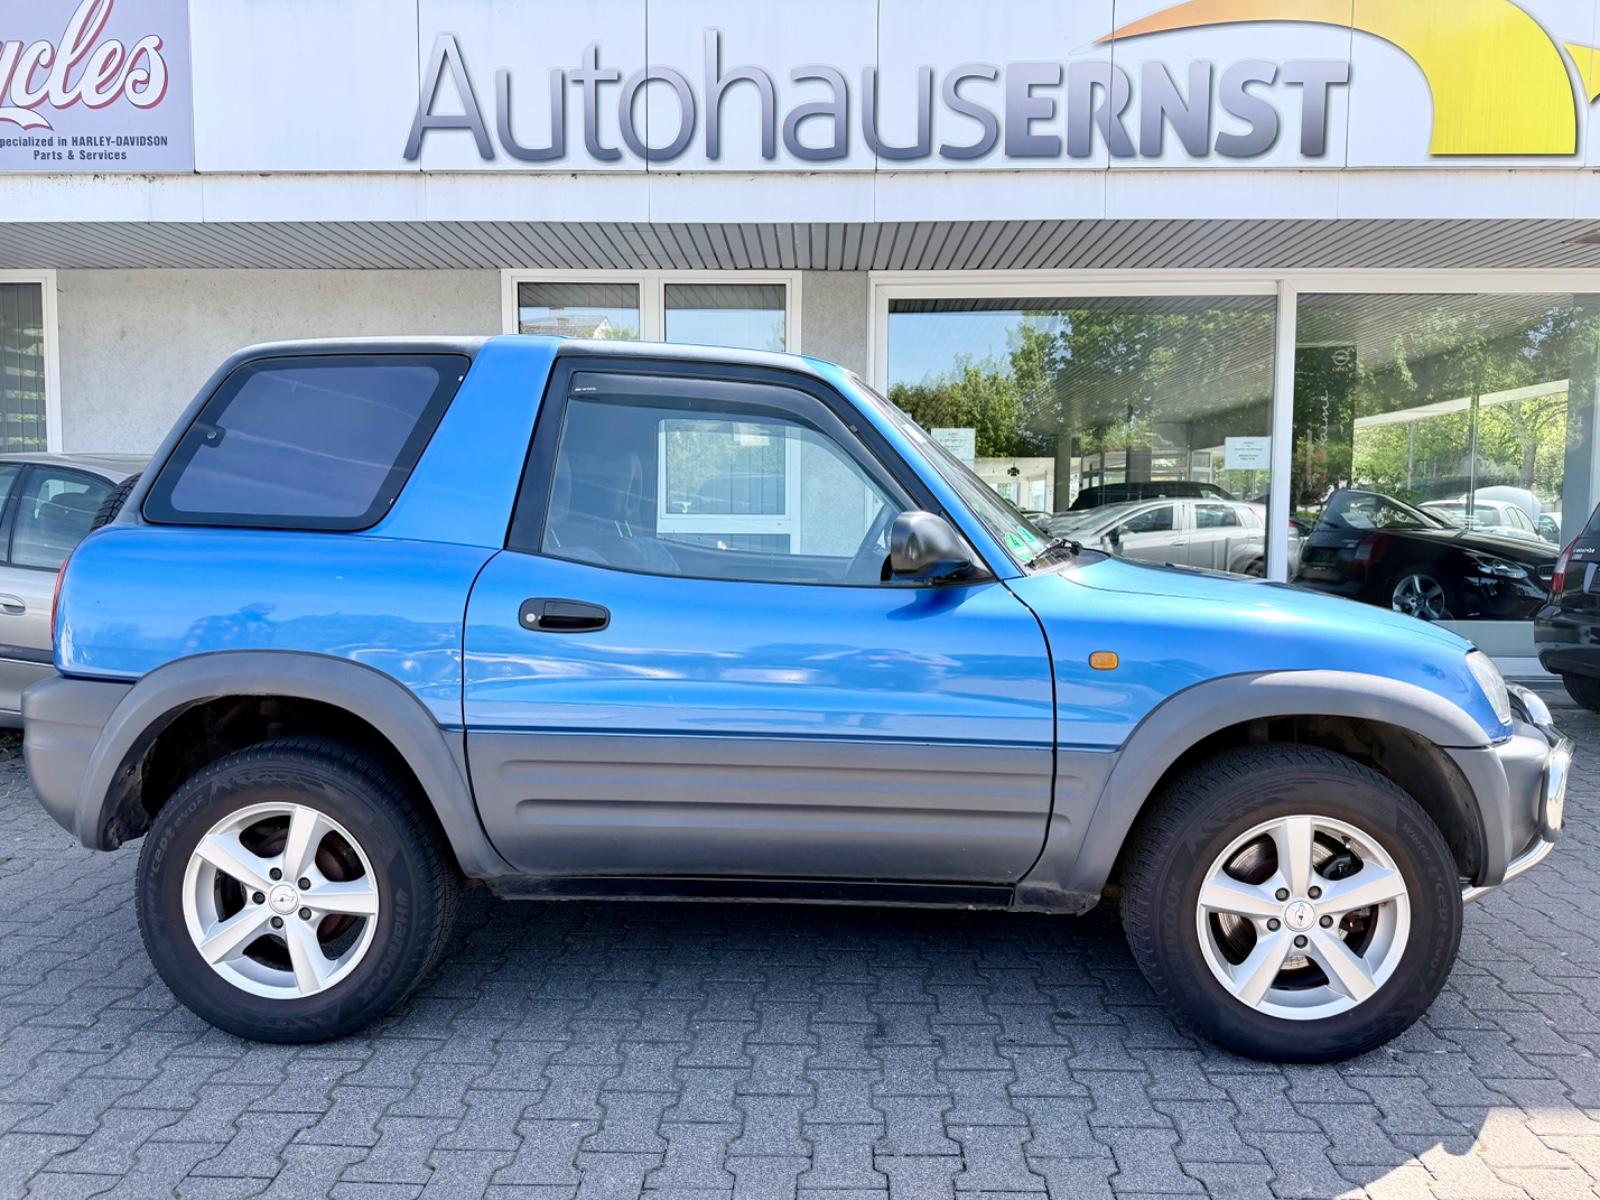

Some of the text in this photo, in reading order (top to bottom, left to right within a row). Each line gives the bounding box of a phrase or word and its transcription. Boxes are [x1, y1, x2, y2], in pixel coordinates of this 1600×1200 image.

[57, 136, 67, 147] in
[71, 135, 168, 147] HARLEY-DAVIDSON
[33, 150, 127, 161] Parts & Services
